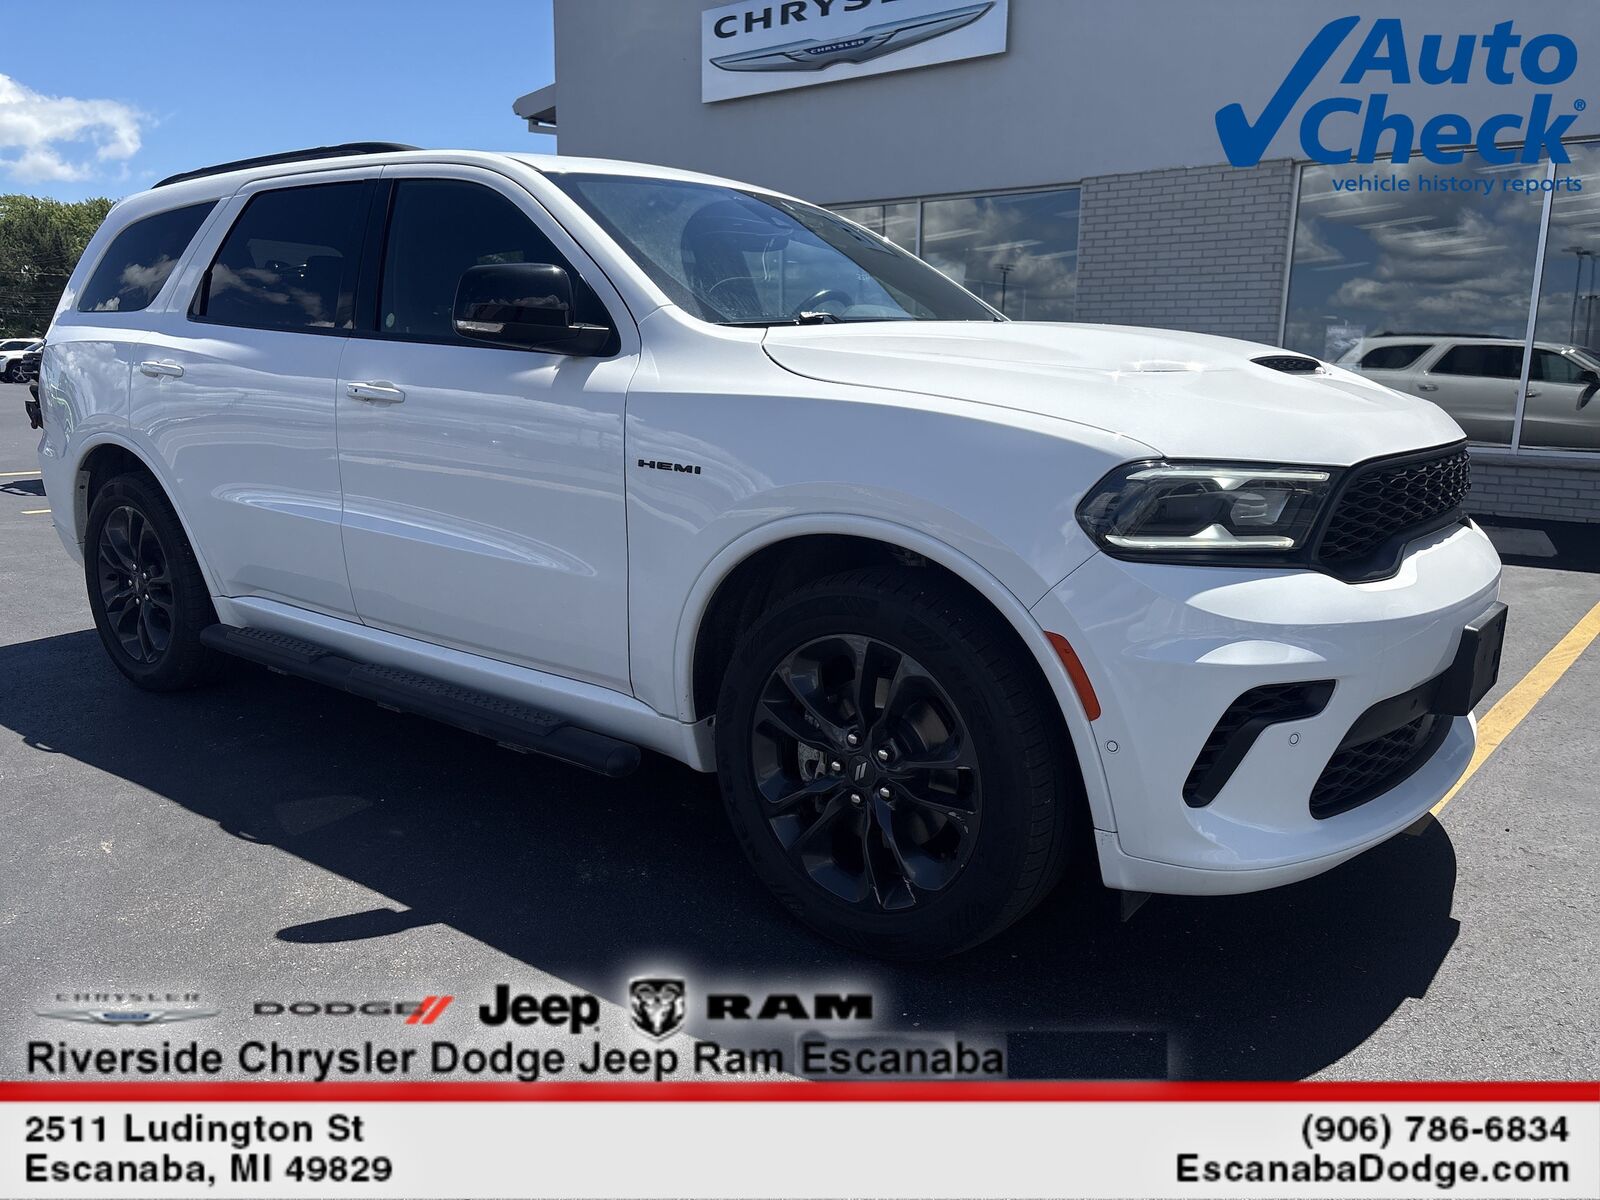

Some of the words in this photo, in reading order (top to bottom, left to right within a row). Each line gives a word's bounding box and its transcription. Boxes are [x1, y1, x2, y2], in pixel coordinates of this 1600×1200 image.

[714, 0, 897, 39] CHRYS
[810, 39, 865, 54] CHRYSLER
[637, 459, 702, 475] HEMI
